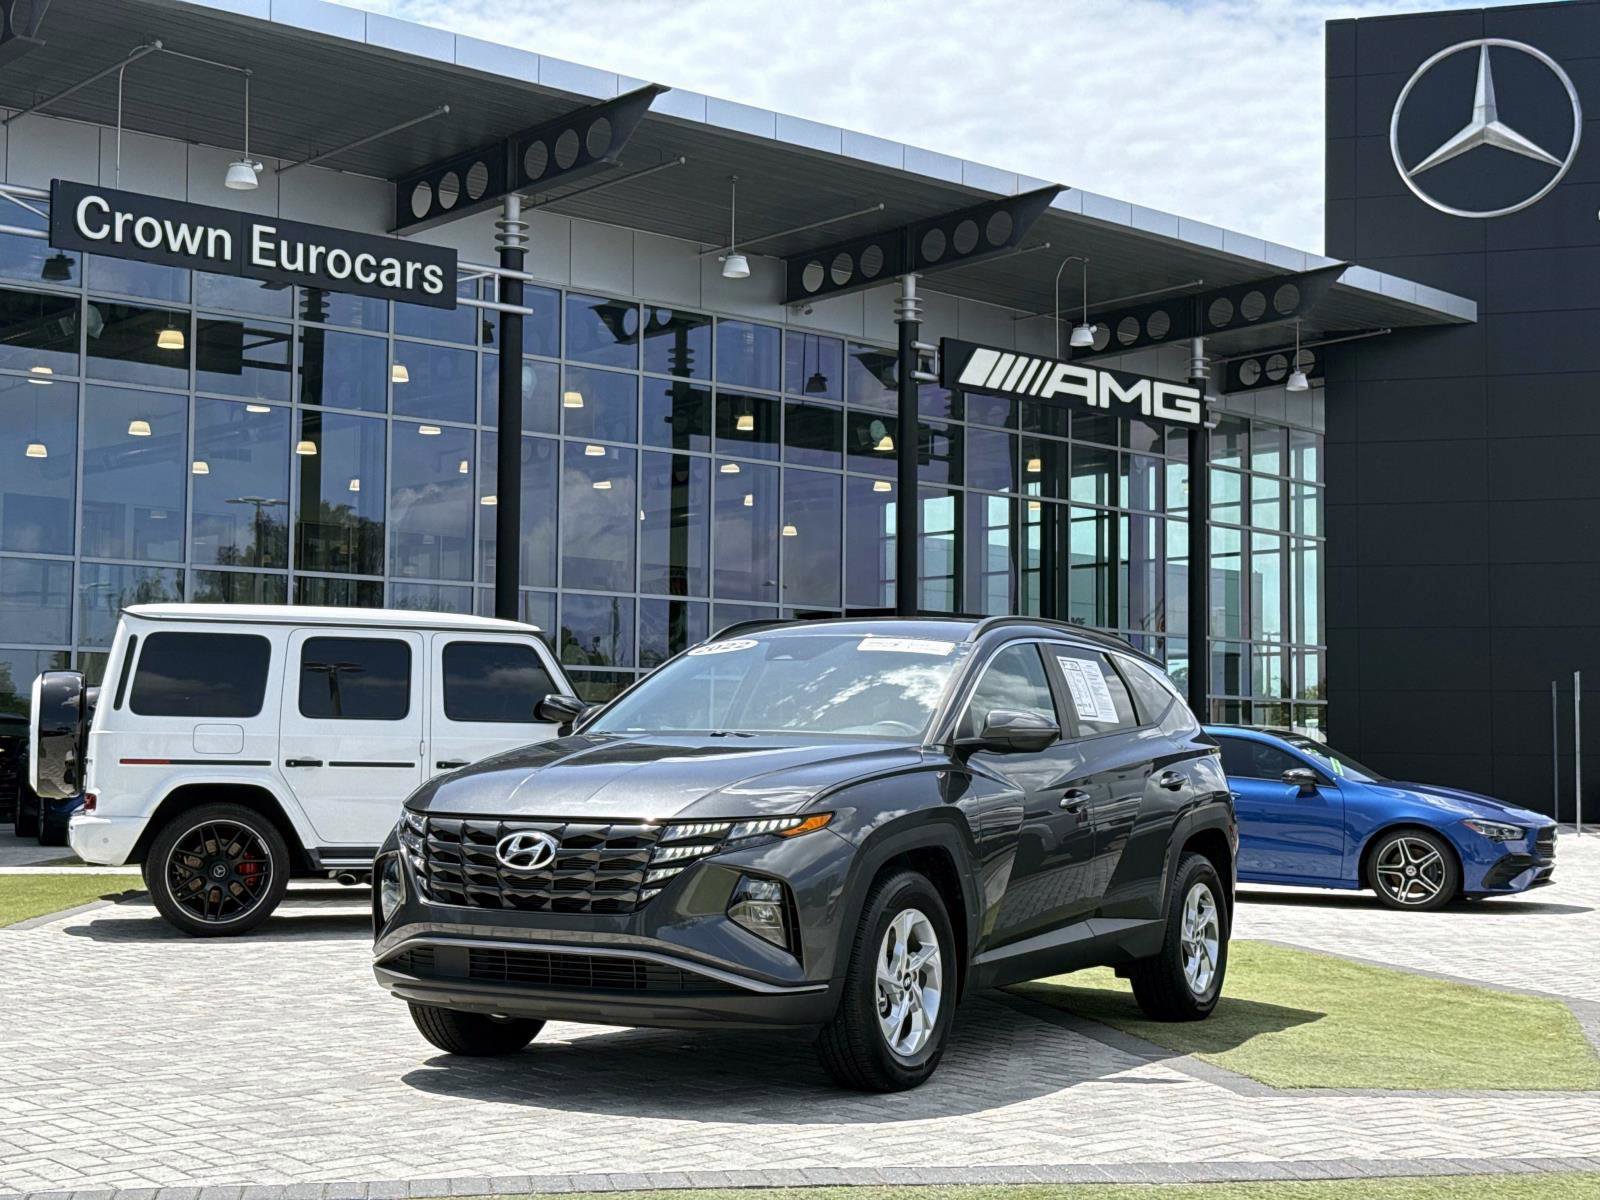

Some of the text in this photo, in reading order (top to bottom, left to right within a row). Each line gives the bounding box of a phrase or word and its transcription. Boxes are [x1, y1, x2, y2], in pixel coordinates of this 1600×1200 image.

[75, 194, 444, 295] Crown Eurocars
[1040, 362, 1201, 425] AMG
